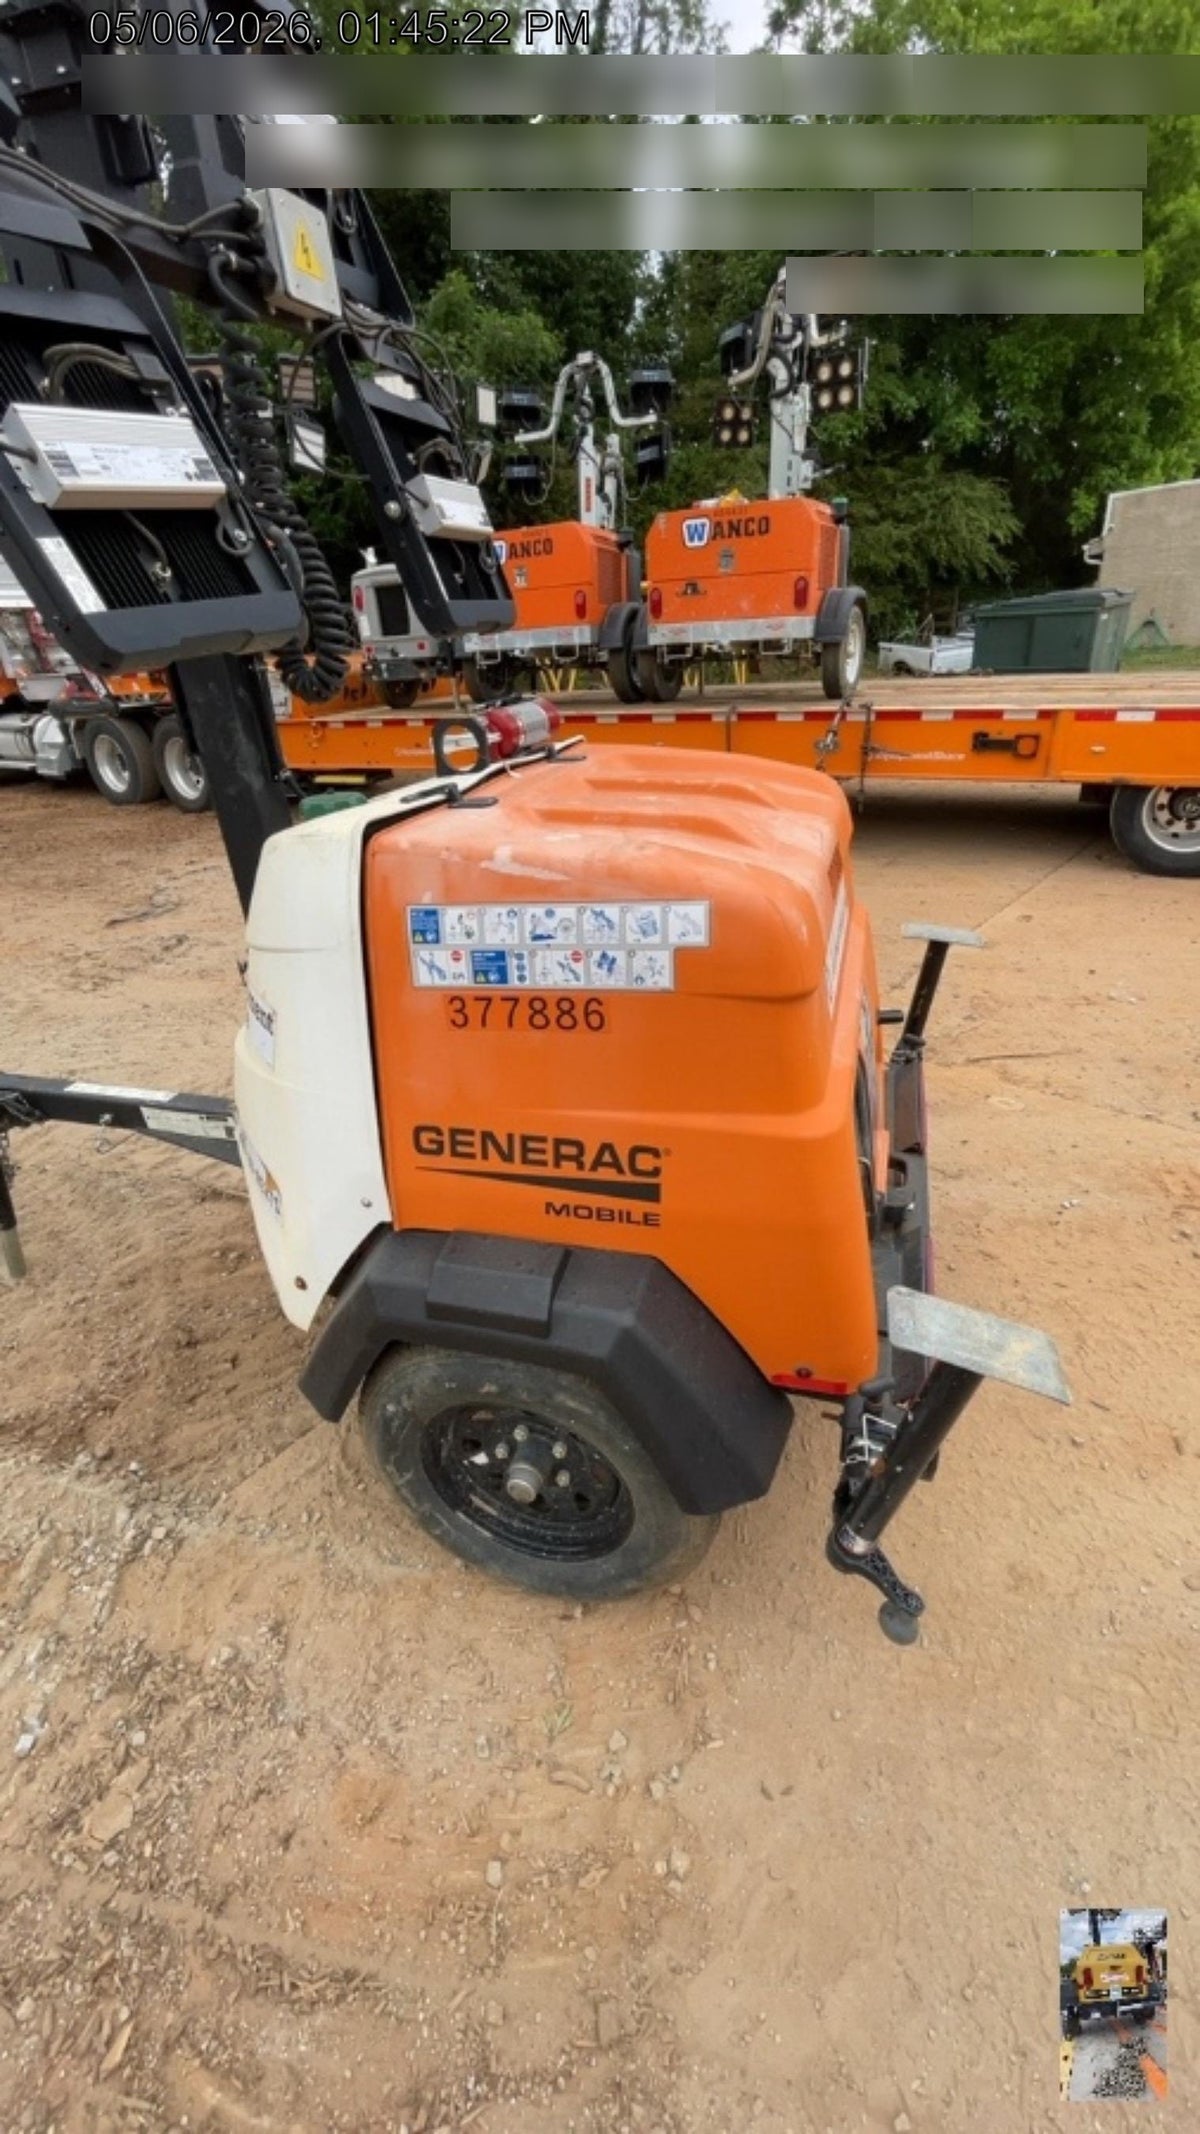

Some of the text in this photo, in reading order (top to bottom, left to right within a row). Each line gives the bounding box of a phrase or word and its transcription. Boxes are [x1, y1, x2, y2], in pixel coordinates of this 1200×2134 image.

[685, 516, 770, 543] WANCO
[448, 995, 606, 1032] 377886
[413, 1124, 662, 1179] GENERAC
[544, 1201, 661, 1227] MOBILE
